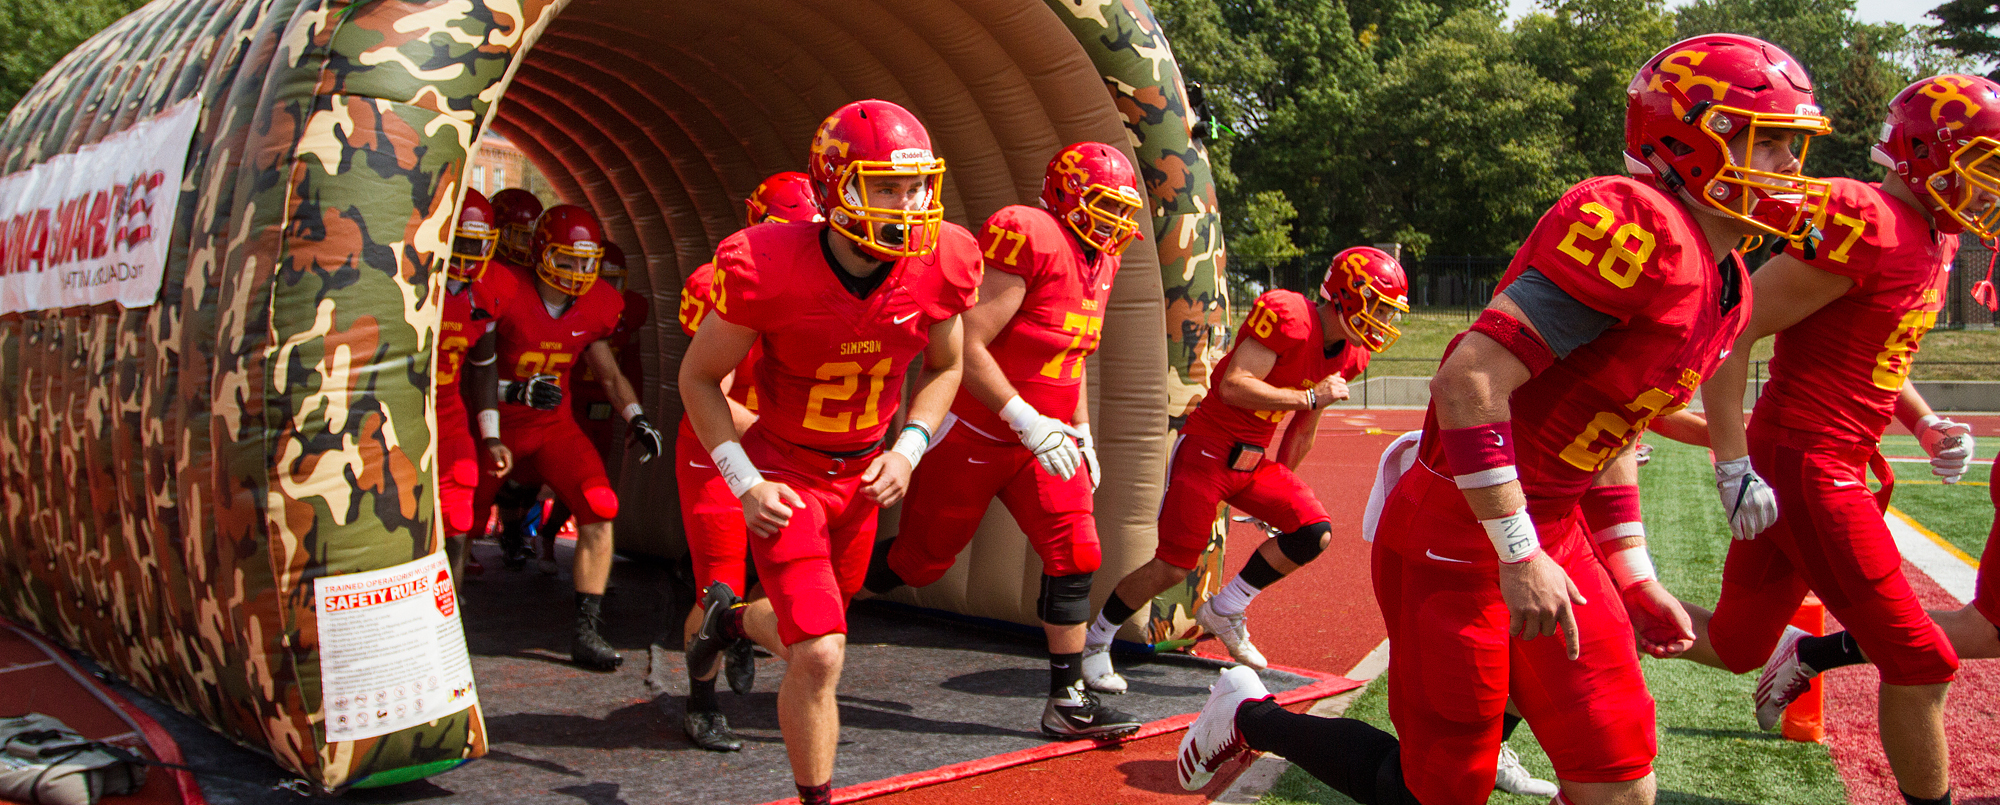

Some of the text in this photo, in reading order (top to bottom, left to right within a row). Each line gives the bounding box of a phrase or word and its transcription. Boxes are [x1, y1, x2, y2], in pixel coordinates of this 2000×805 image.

[901, 151, 923, 159] Riddell
[984, 224, 1027, 266] 77
[1556, 201, 1657, 289] 28
[678, 287, 706, 333] 27
[1248, 301, 1278, 339] 16
[840, 339, 882, 355] SIMPSON
[1040, 312, 1102, 379] 77
[802, 357, 893, 433] 21
[716, 456, 741, 488] AVE
[1500, 516, 1531, 555] AVE
[325, 583, 364, 594] TRAINED
[326, 577, 429, 611] SAFETY RULES
